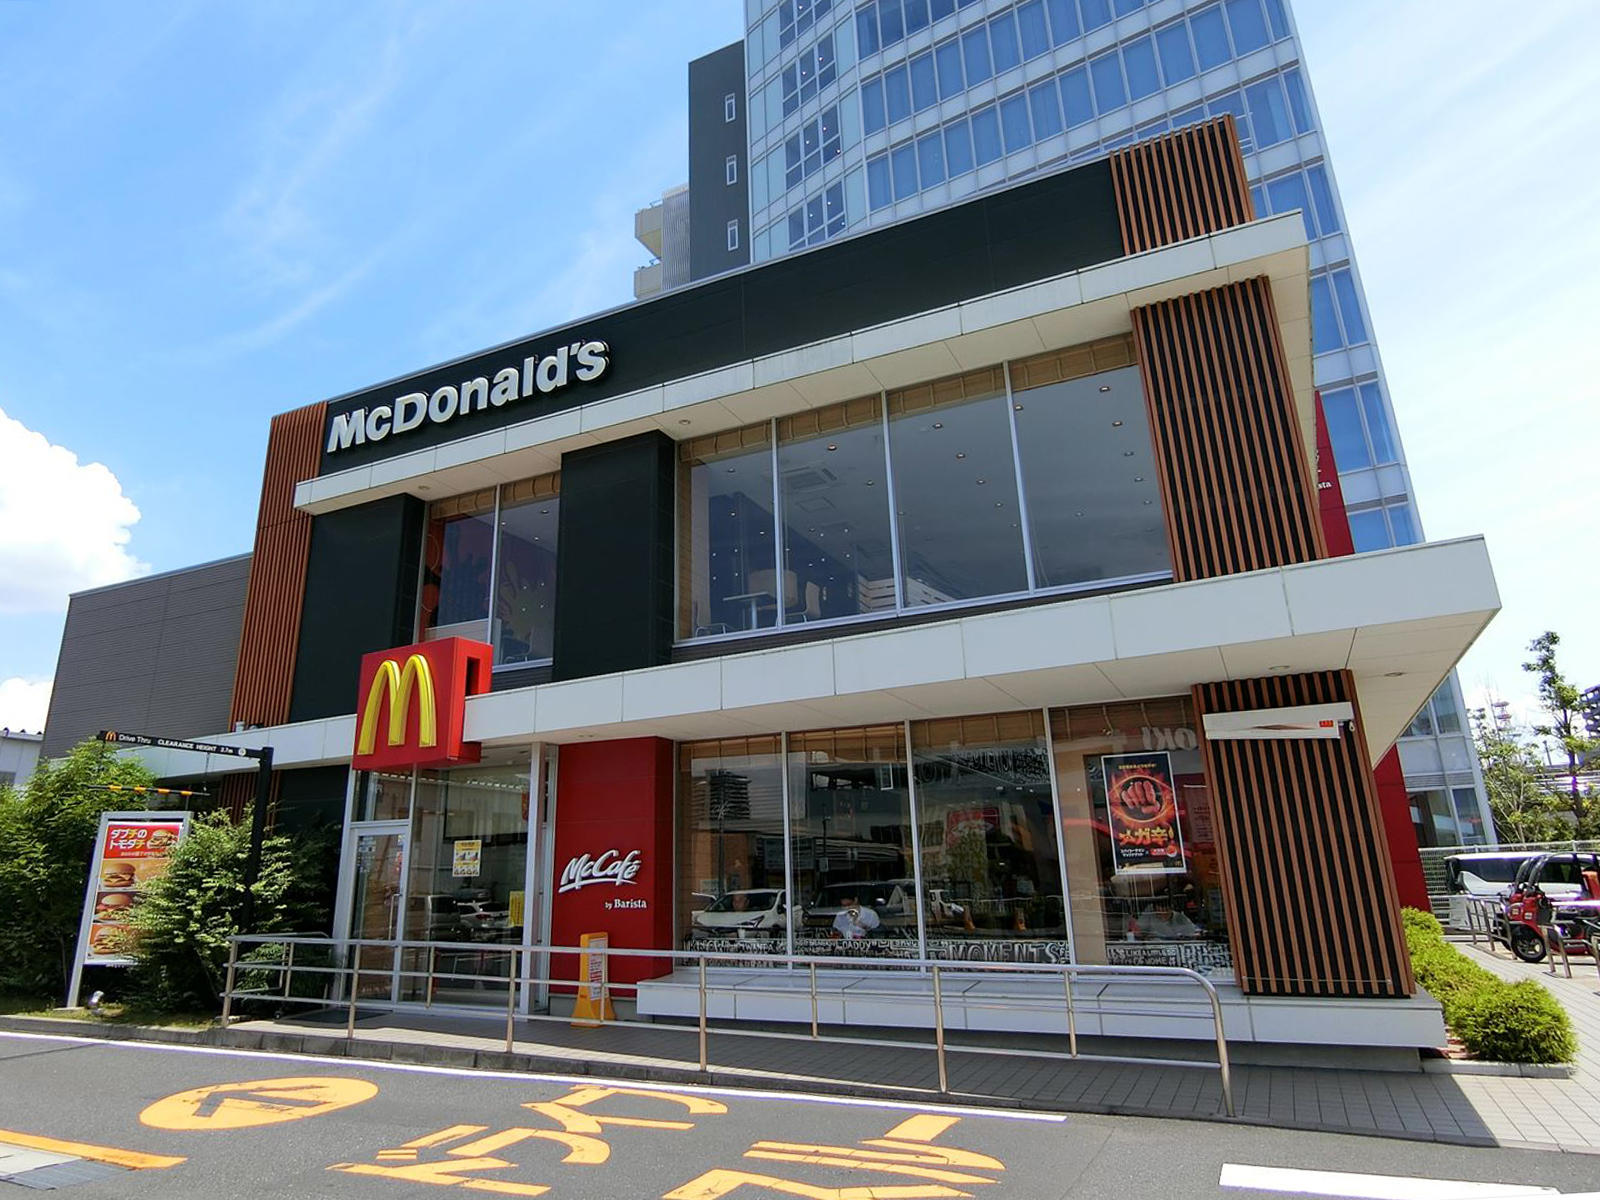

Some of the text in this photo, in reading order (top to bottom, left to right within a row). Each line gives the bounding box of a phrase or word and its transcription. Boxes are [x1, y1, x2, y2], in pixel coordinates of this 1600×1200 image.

[327, 340, 609, 453] McDonald's
[119, 734, 136, 743] Drive
[137, 736, 151, 744] Thru
[157, 739, 194, 749] CLEARANCE
[196, 744, 217, 752] HEIGHT
[109, 839, 145, 850] トモダチ
[559, 850, 642, 892] McCafé
[605, 899, 647, 910] by Barista
[948, 942, 1059, 963] MOMENTS
[324, 1084, 729, 1197] ドライブ
[661, 1113, 1006, 1200] スルー
